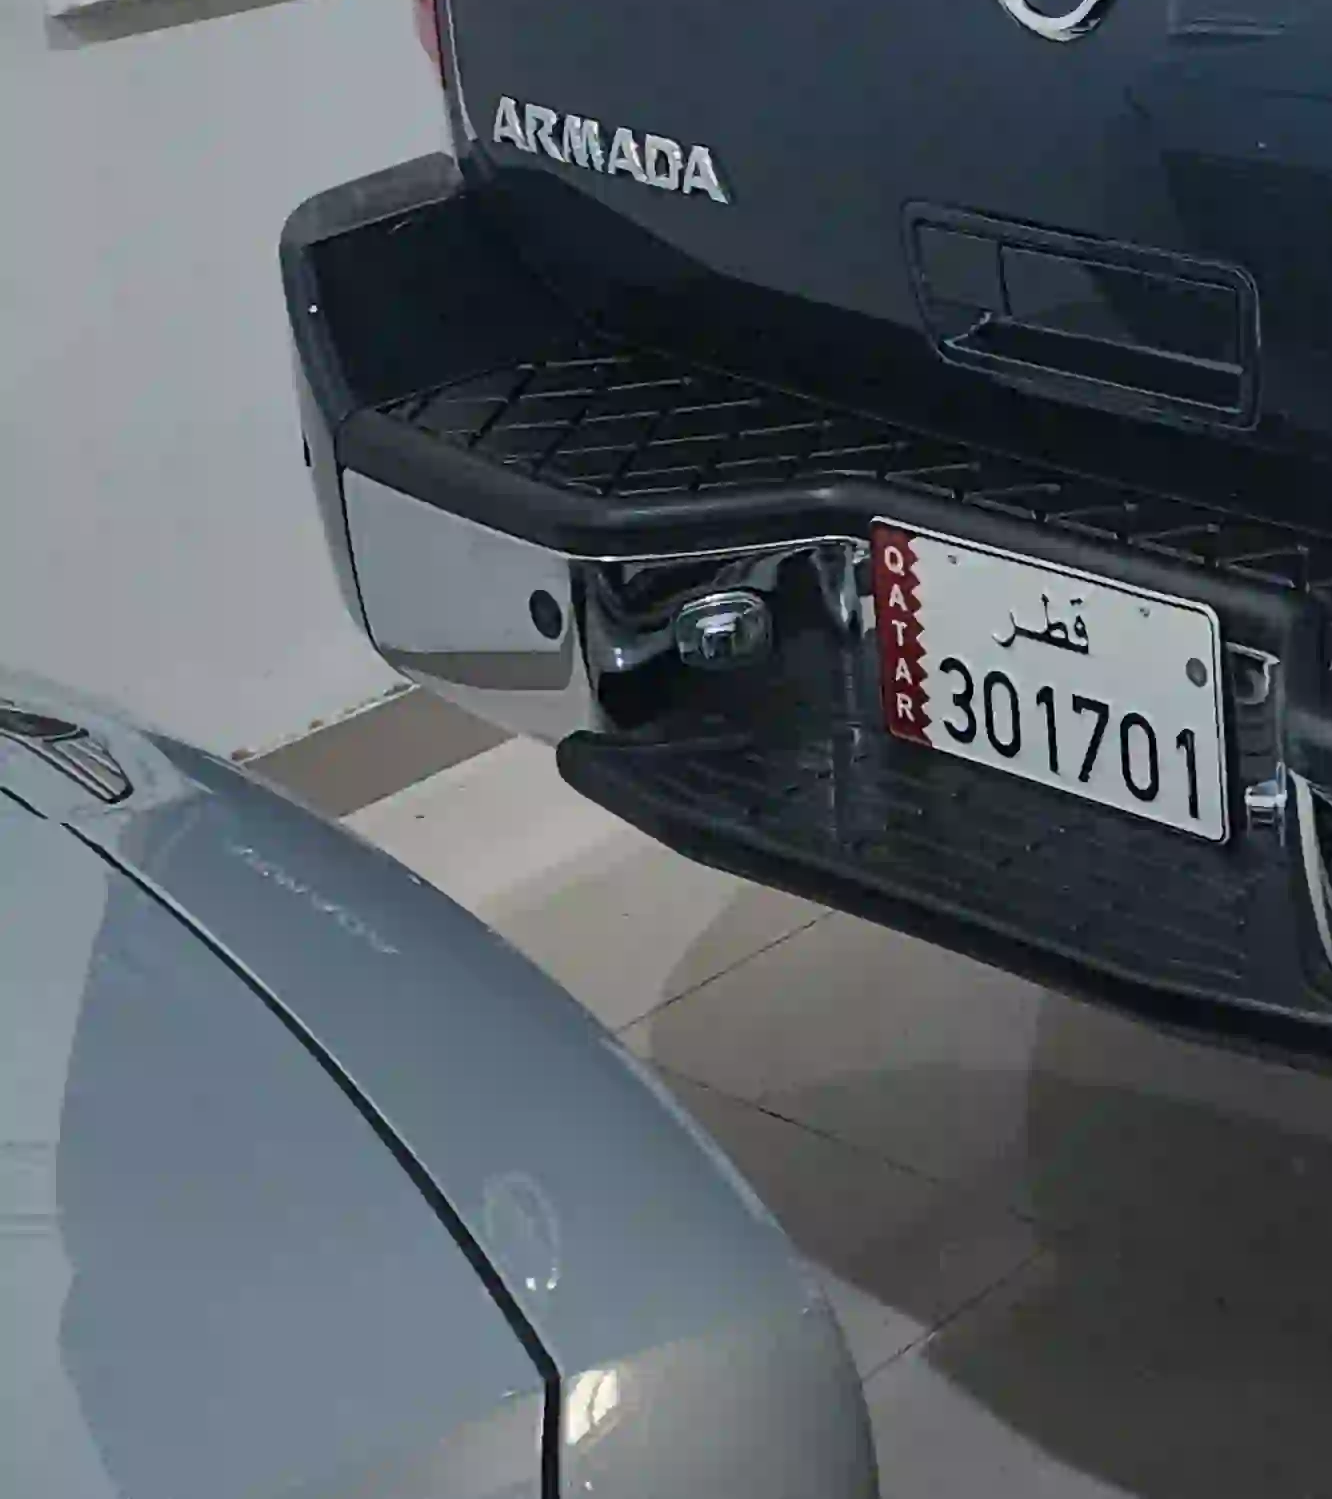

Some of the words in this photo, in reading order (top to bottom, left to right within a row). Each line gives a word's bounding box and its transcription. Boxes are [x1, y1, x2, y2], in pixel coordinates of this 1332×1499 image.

[493, 95, 730, 205] ARMADA
[883, 544, 916, 723] QATAR
[992, 593, 1091, 655] قطر
[938, 656, 1200, 819] 301701
